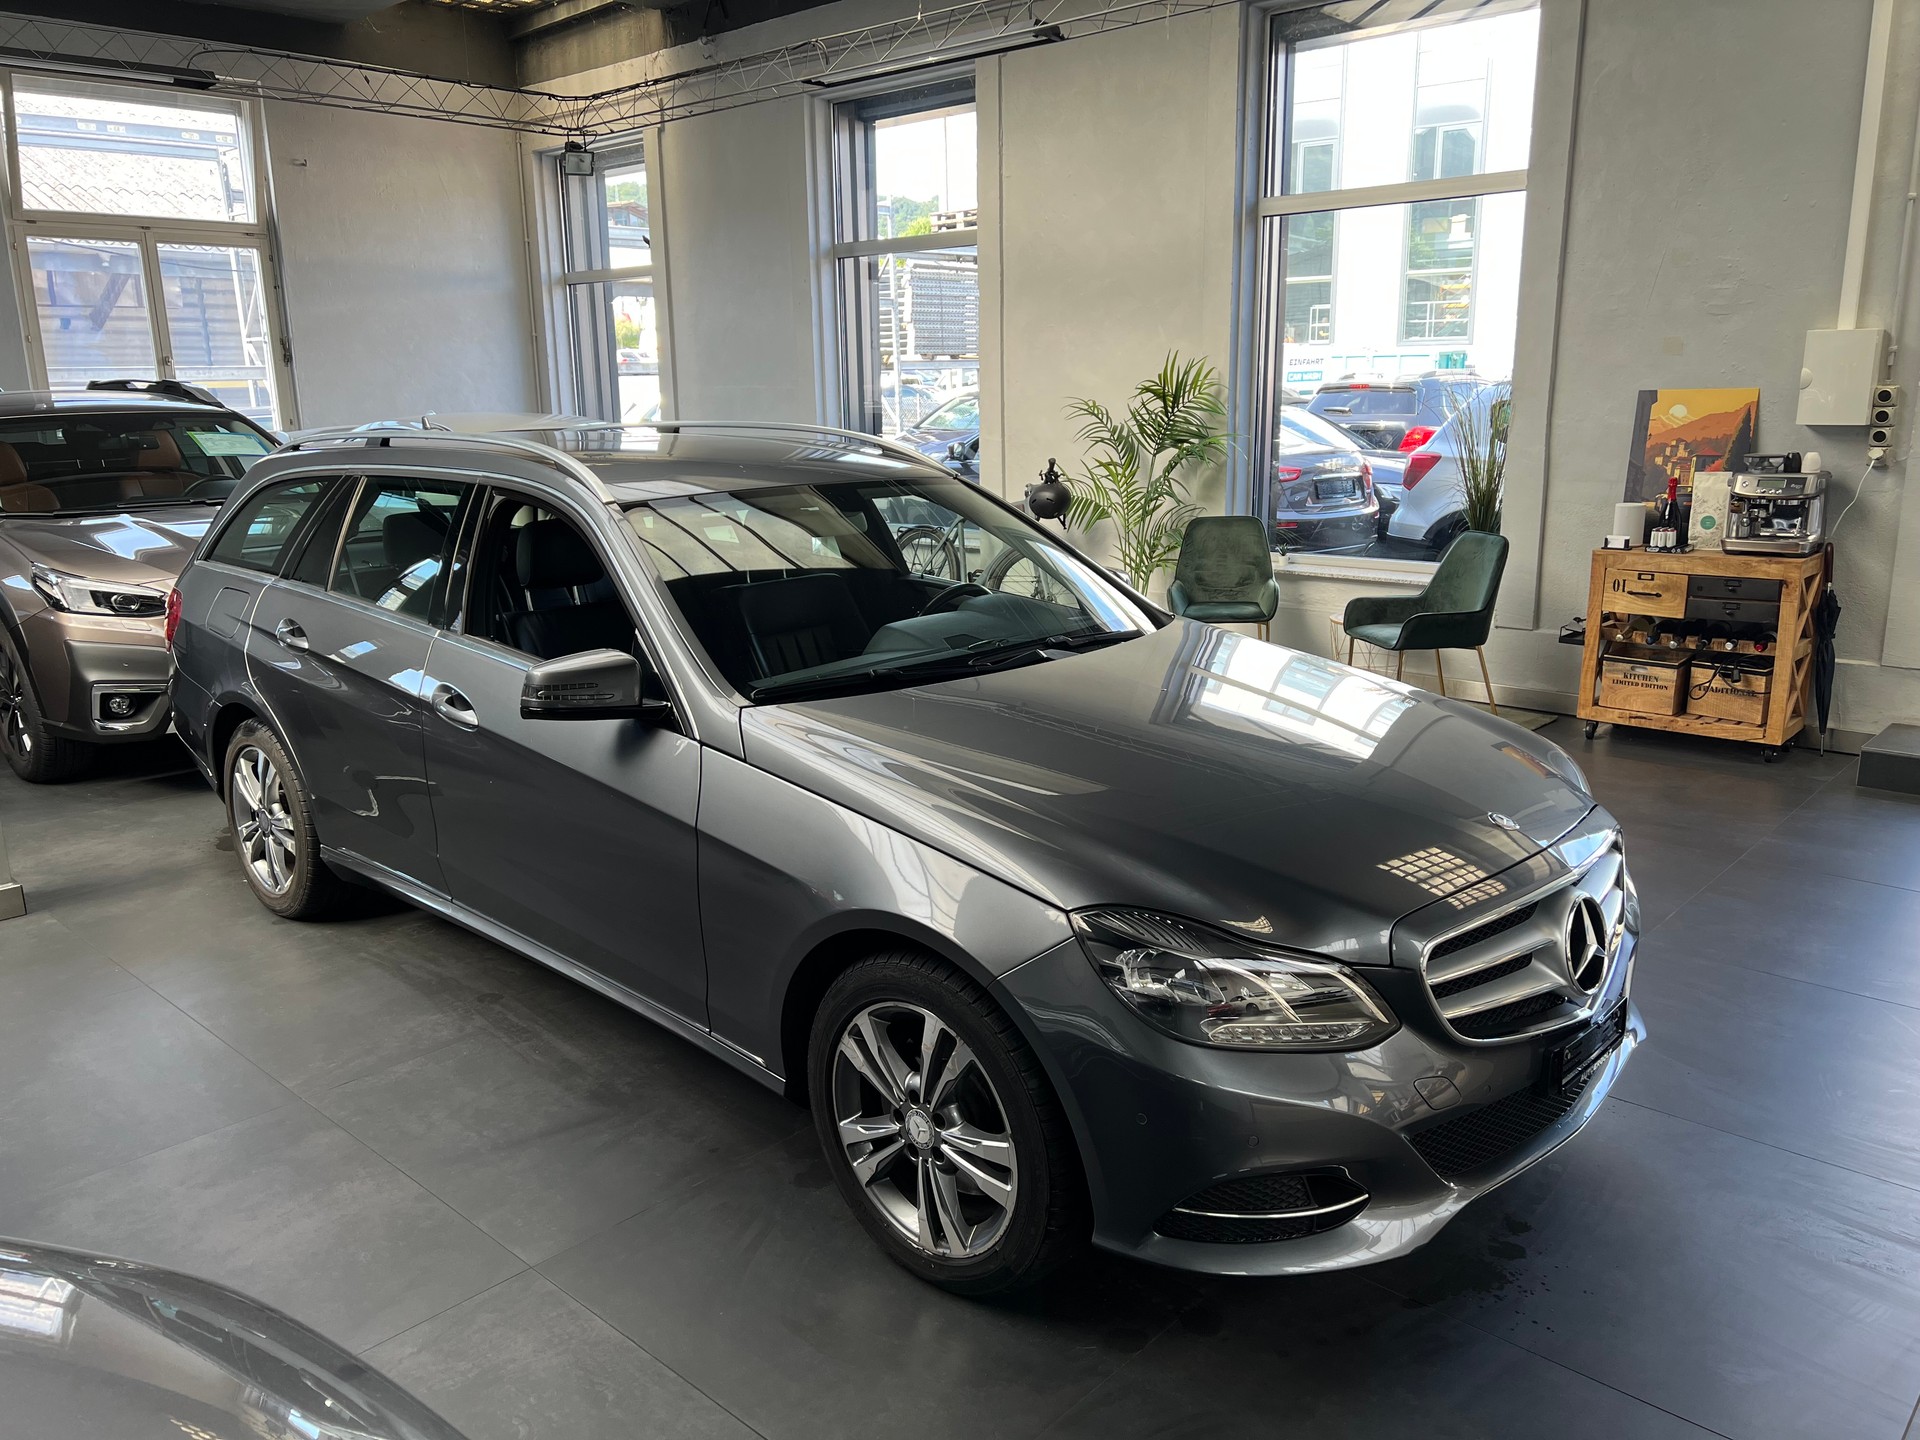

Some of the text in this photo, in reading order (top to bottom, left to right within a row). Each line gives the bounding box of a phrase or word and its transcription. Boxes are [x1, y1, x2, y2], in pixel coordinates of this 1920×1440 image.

[1289, 358, 1324, 366] EINFAHRT
[1288, 373, 1302, 381] CAR
[1623, 672, 1659, 682] KITCHEN
[1612, 679, 1669, 690] LIMITED EDITION
